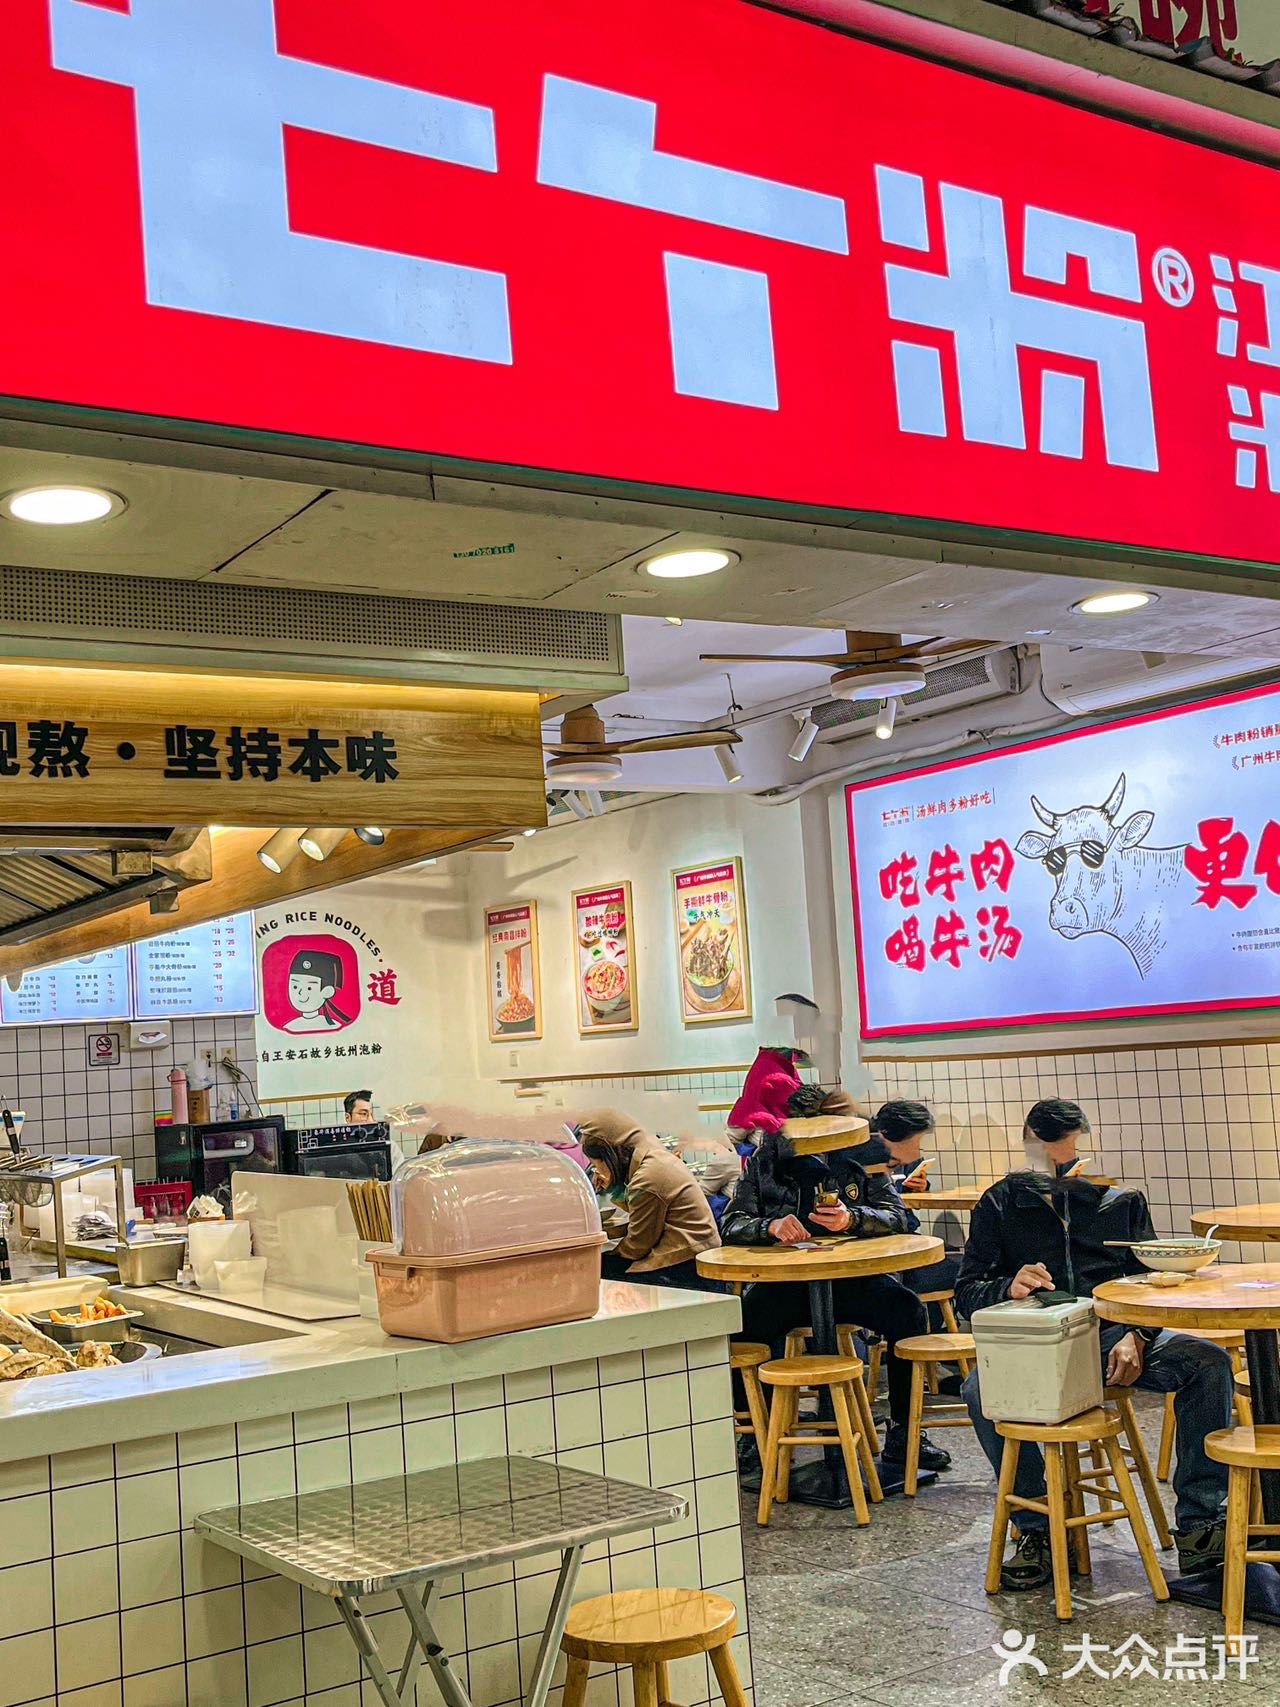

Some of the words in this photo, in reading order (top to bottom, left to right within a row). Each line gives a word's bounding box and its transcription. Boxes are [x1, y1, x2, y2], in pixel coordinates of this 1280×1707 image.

[878, 837, 1015, 908] 吃牛肉
[285, 911, 318, 924] RICE
[885, 905, 1022, 972] 喝牛汤
[367, 968, 402, 1006] 道
